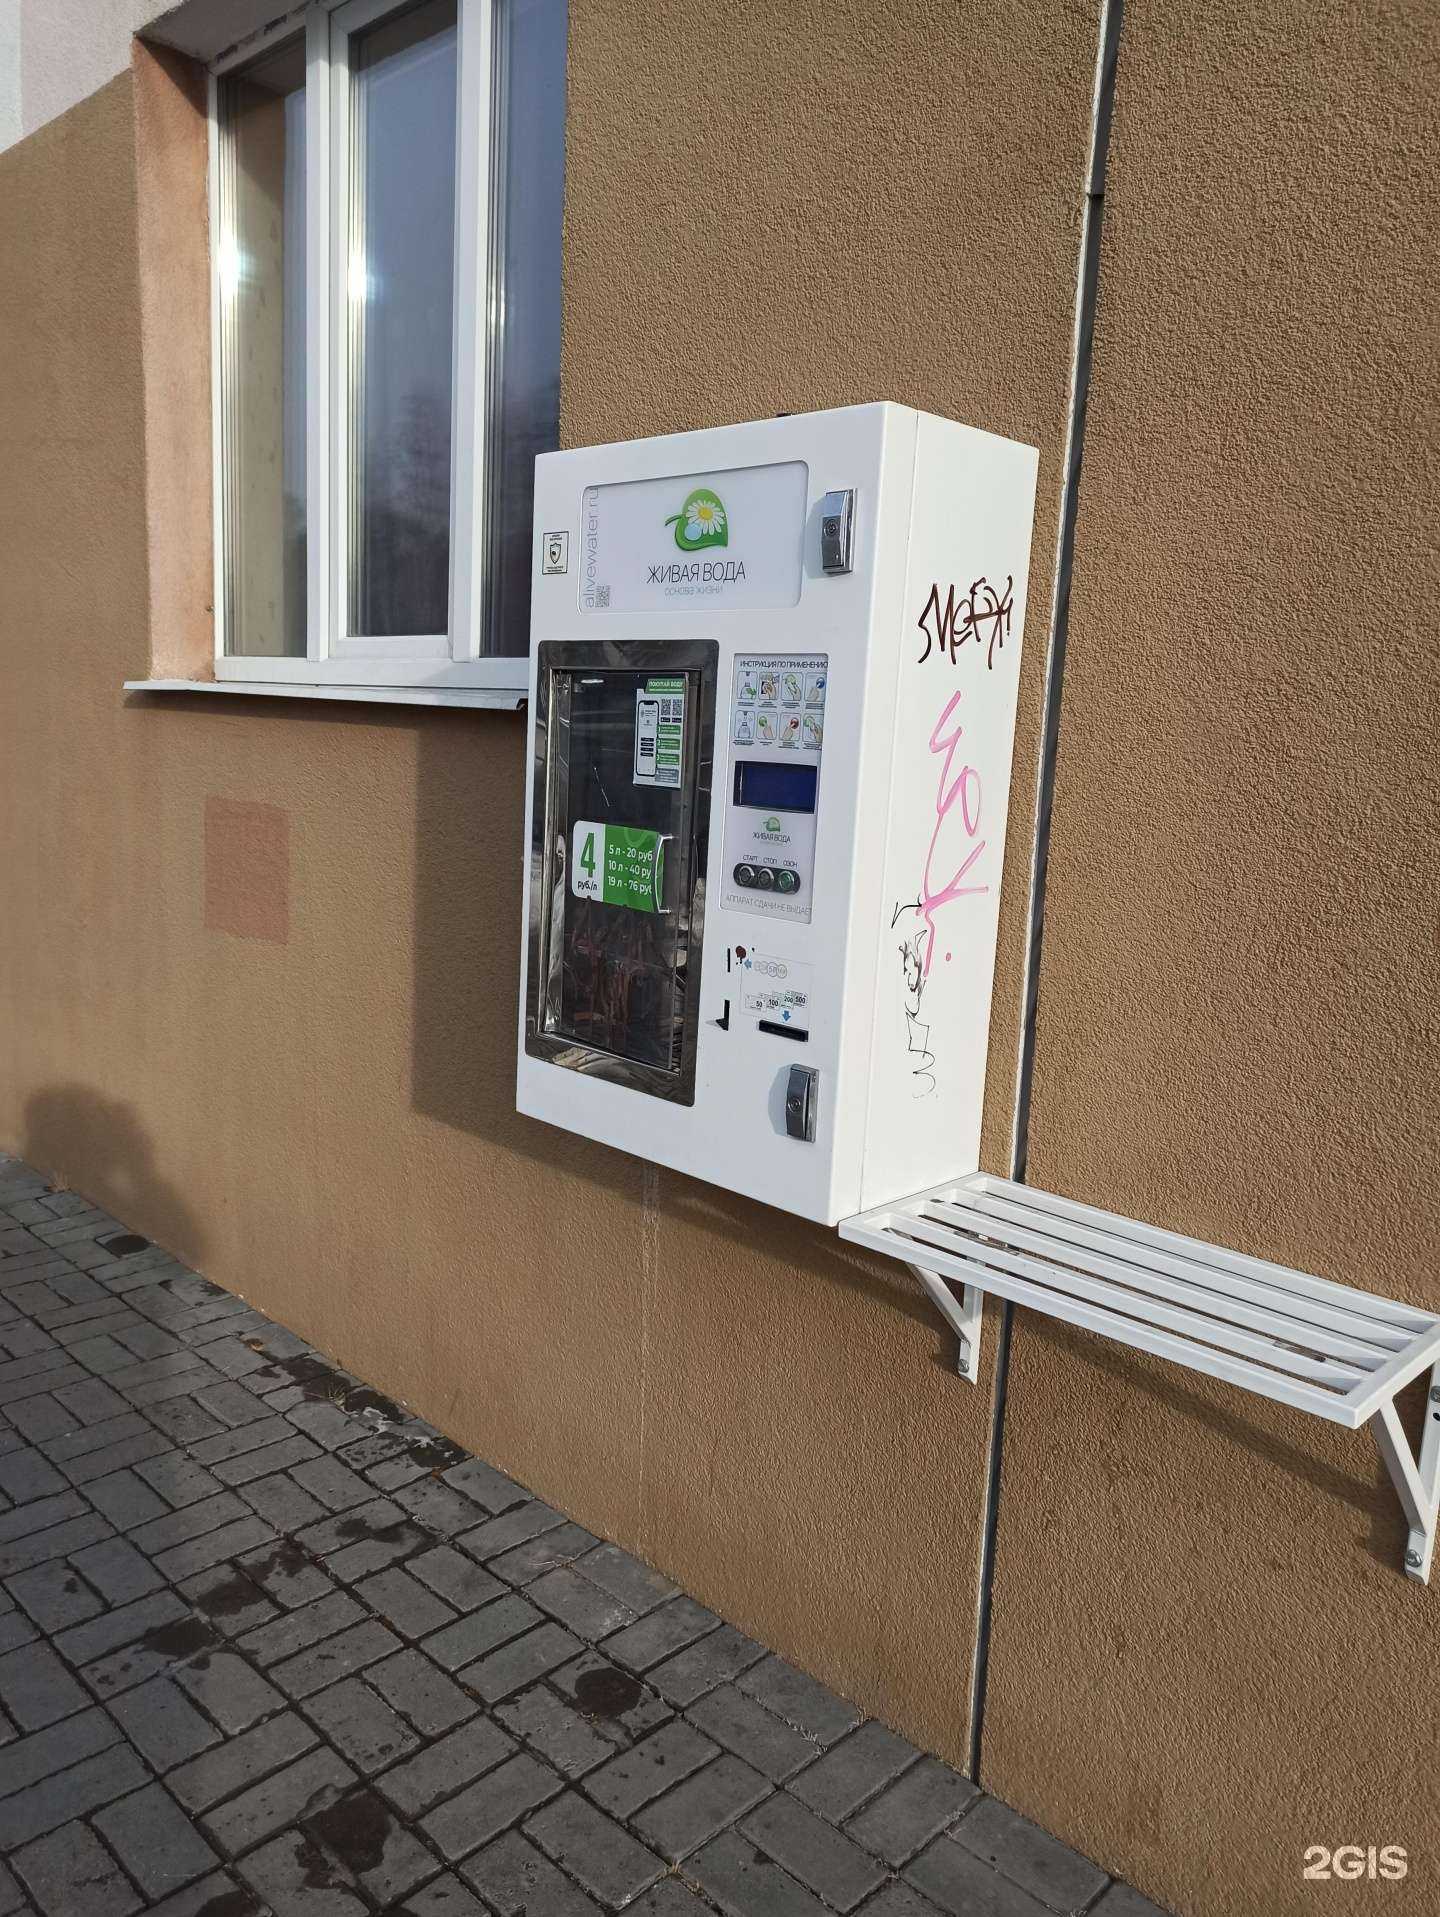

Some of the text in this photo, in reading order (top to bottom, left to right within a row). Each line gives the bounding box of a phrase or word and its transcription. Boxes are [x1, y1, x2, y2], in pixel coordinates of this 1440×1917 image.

[583, 487, 599, 609] alivewater.ru
[646, 561, 746, 584] ЖИВАЯ ВОДА
[580, 832, 596, 878] 4
[609, 844, 614, 855] 5
[615, 847, 621, 855] л
[626, 847, 636, 858] 20
[608, 860, 617, 871] 10
[617, 863, 623, 872] л
[630, 865, 640, 875] 40
[608, 875, 616, 886] 19
[617, 879, 622, 887] л
[628, 880, 638, 891] 76
[769, 999, 778, 1007] 100
